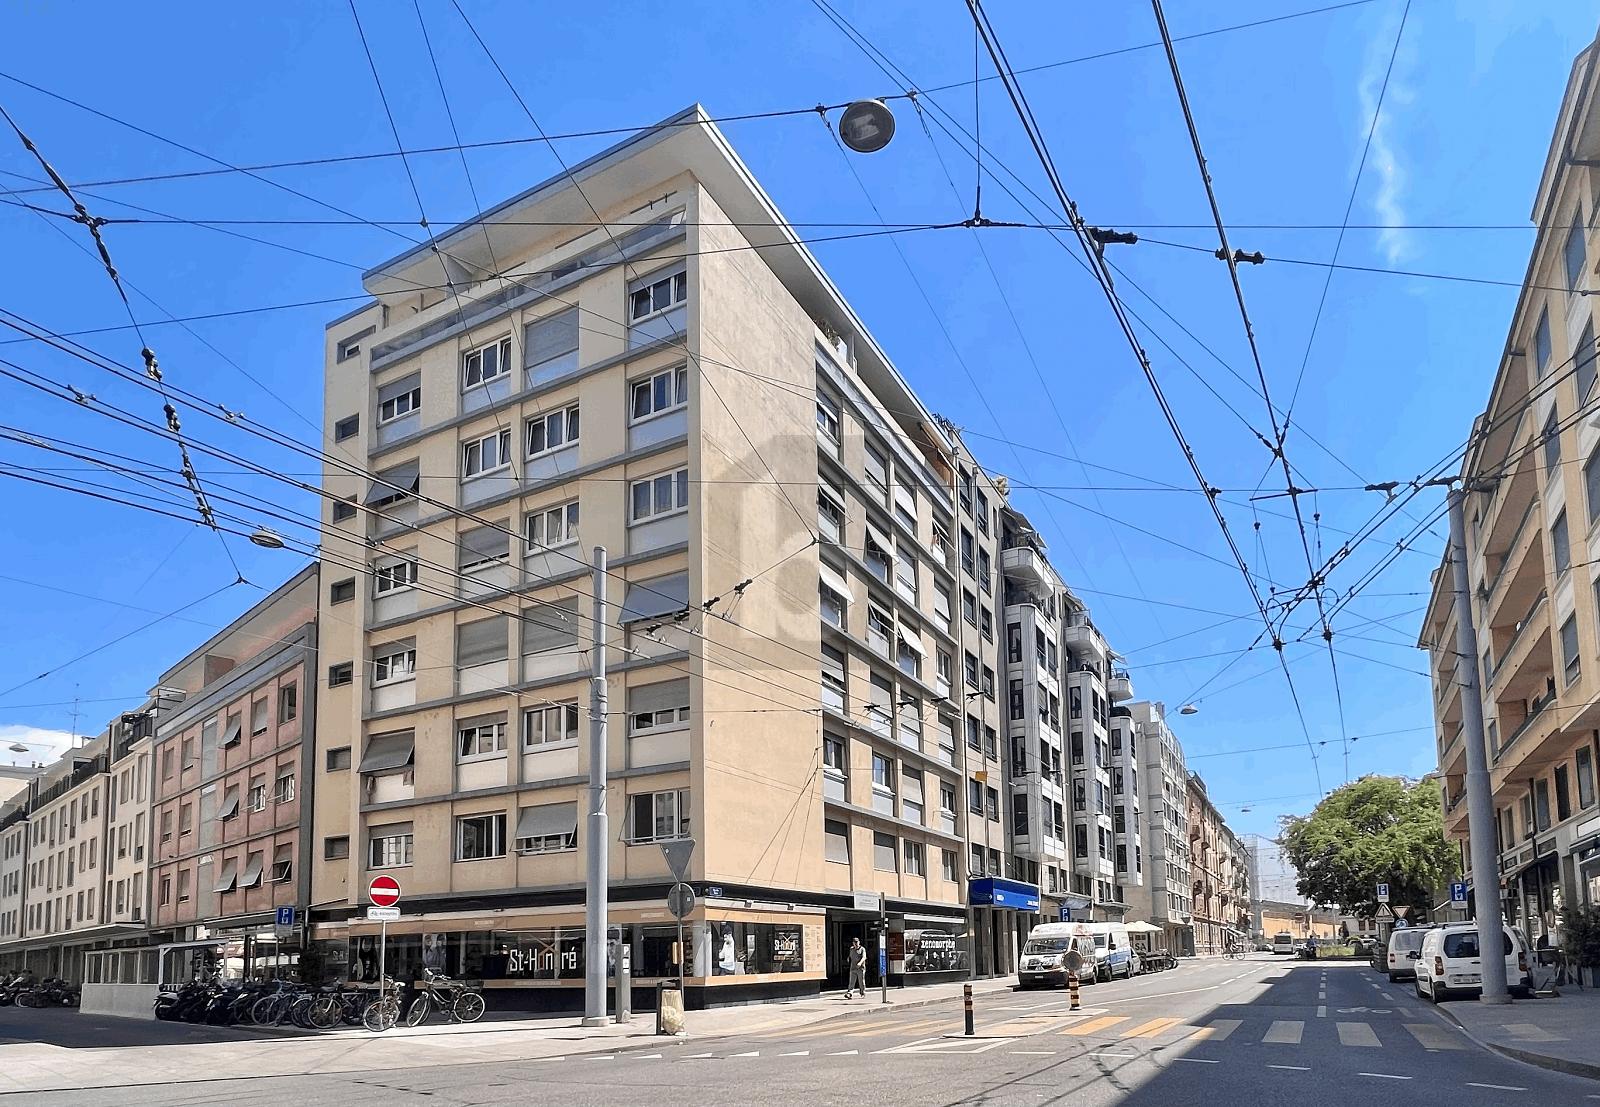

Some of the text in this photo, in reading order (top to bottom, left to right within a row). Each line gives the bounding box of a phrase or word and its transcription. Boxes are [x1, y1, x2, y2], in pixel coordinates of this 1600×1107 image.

[1454, 884, 1462, 893] P
[623, 946, 629, 955] P
[509, 946, 577, 972] St-Honré
